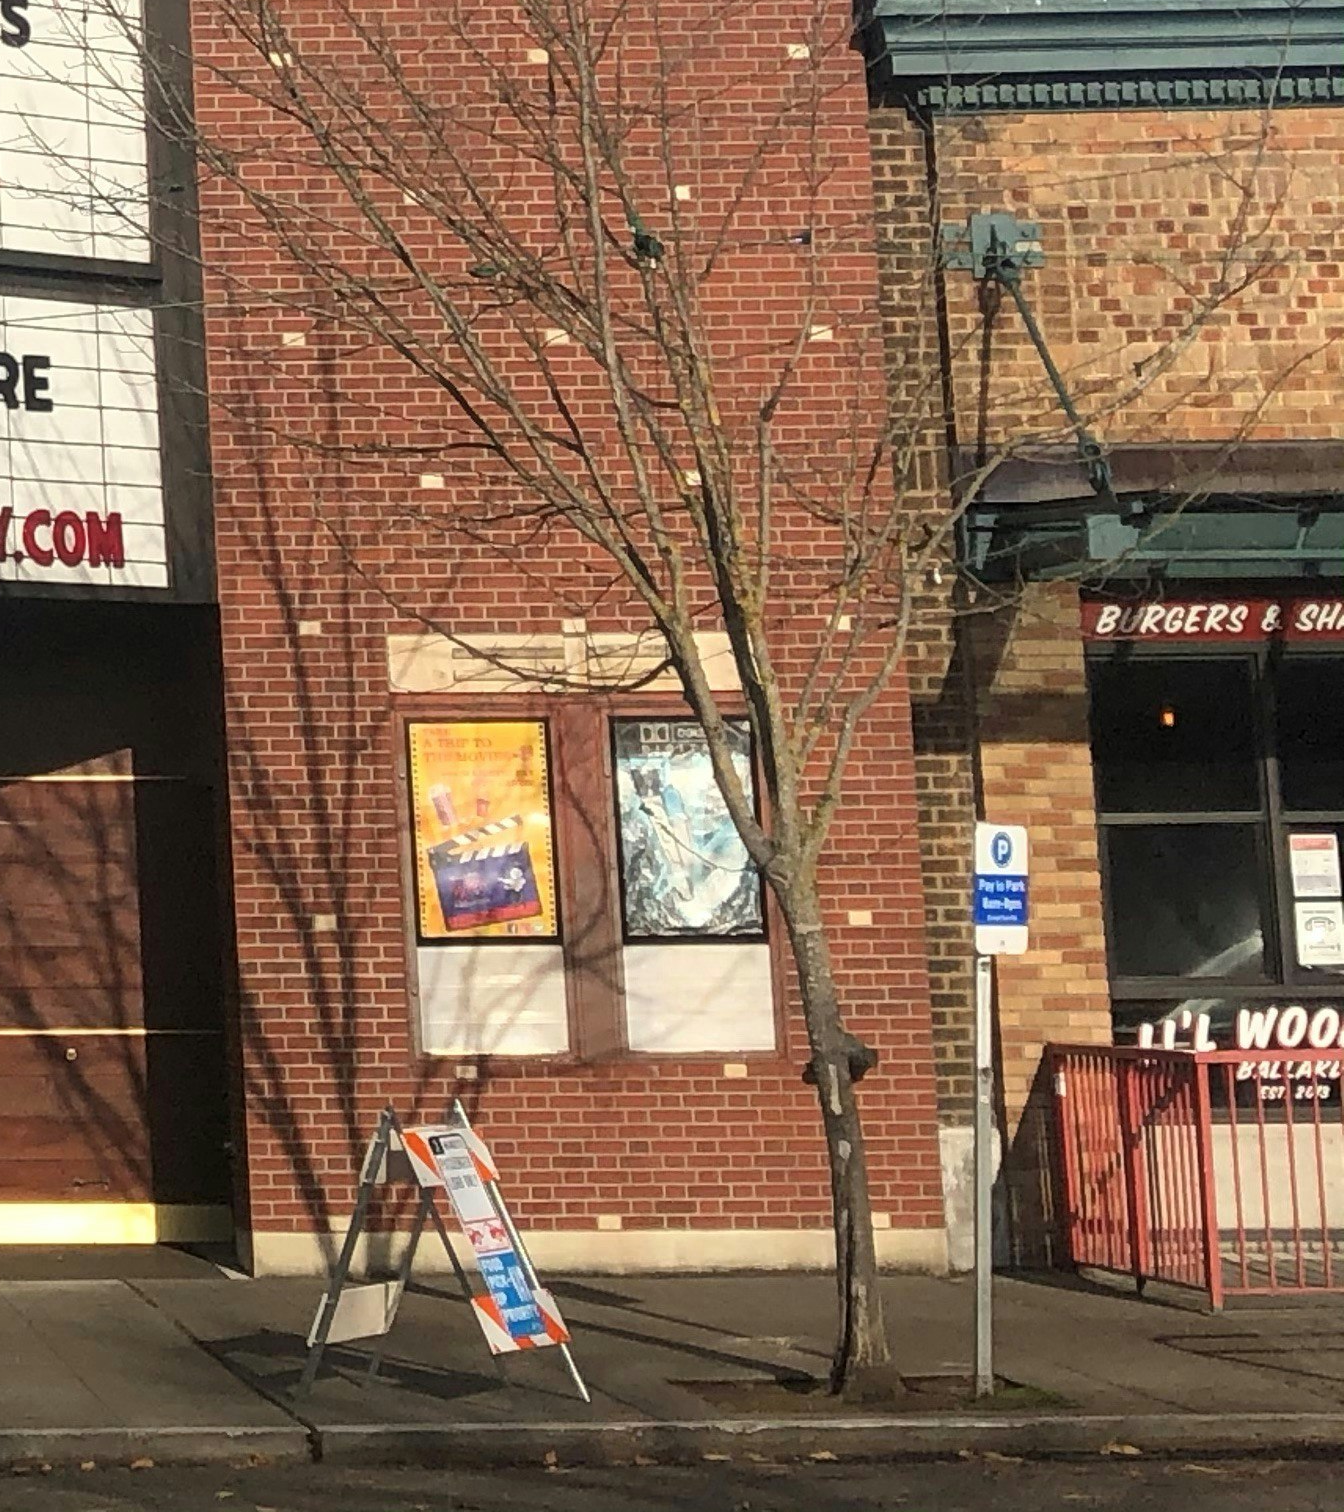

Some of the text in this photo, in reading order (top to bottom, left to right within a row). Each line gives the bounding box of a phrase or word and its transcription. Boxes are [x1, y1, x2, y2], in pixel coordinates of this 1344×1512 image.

[1095, 603, 1249, 634] BURGERS
[1261, 604, 1282, 632] &
[1237, 1005, 1344, 1050] WOO
